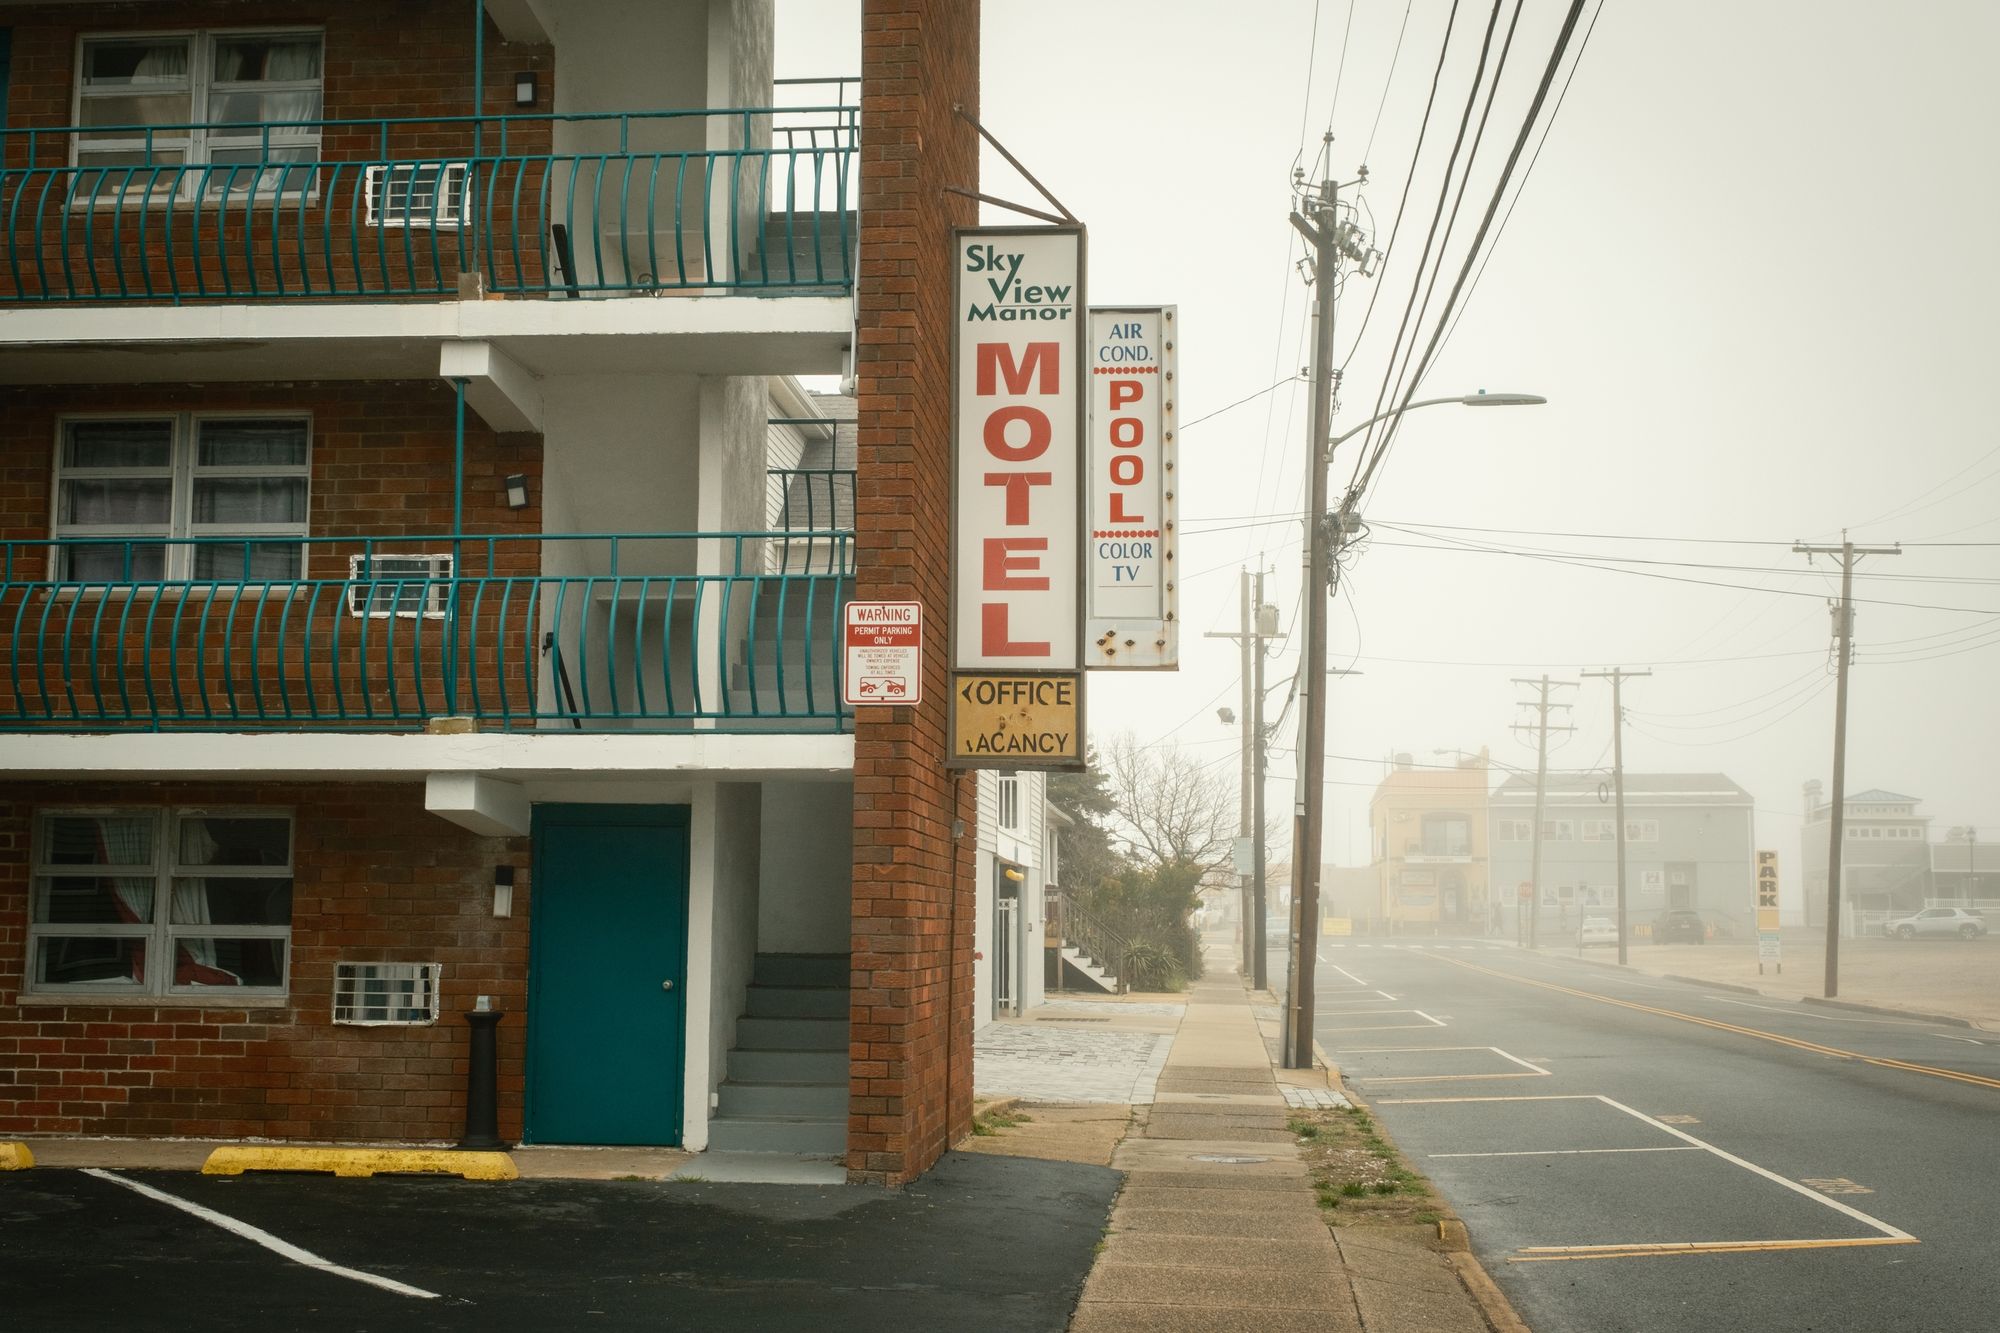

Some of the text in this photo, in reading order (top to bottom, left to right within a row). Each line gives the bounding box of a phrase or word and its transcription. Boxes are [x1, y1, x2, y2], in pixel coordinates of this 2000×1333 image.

[966, 244, 1025, 281] Sky
[987, 277, 1072, 304] View
[967, 302, 1072, 322] Manor
[1109, 323, 1143, 339] AIR
[1099, 345, 1153, 362] COND.
[1109, 380, 1144, 523] POOL
[976, 342, 1060, 657] MOTEL
[1099, 542, 1153, 560] COLOR
[1111, 565, 1140, 582] TV
[857, 608, 911, 621] WARNING
[854, 626, 913, 635] PERMIT PARKING
[874, 636, 893, 644] ONLY
[975, 680, 1071, 705] OFFICE
[1759, 851, 1777, 907] PARK
